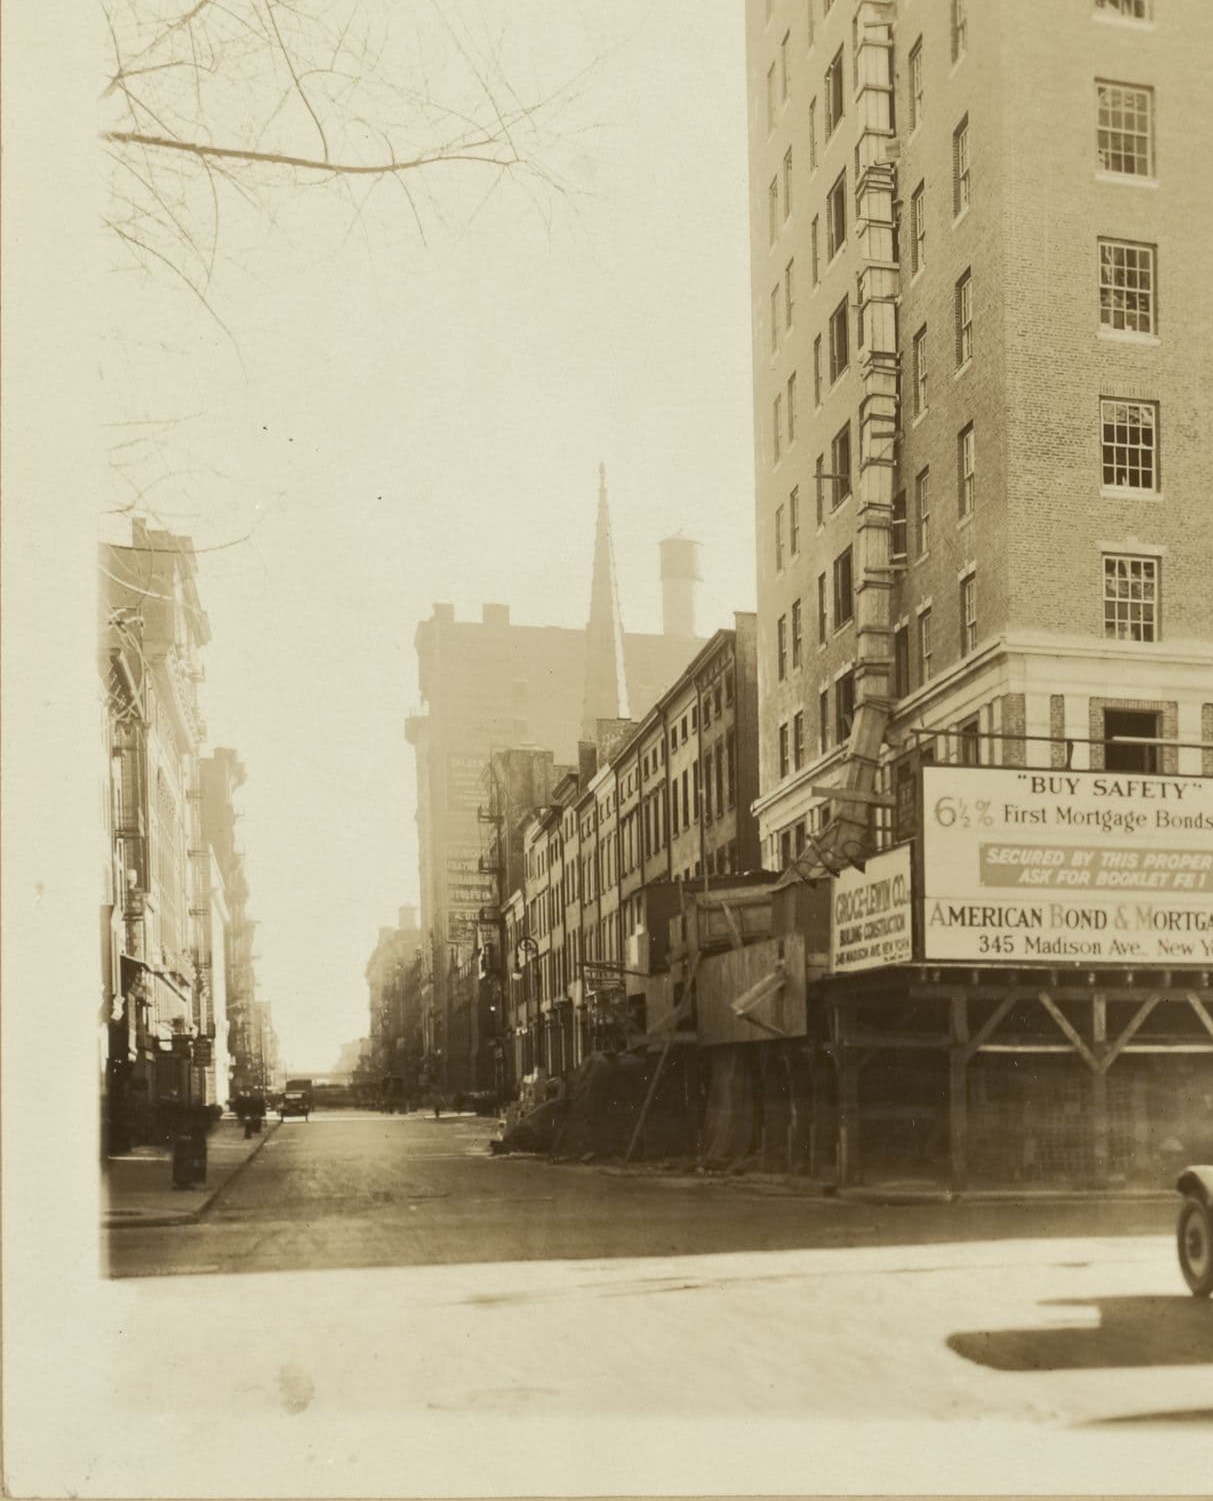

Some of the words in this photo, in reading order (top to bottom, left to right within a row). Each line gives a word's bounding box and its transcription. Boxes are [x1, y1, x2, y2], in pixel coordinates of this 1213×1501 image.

[1004, 804, 1046, 824] First
[1056, 806, 1147, 832] Mortgage
[986, 848, 1065, 867] SECURED
[1070, 850, 1095, 867] BY
[1100, 851, 1139, 869] THIS
[1017, 868, 1052, 885] ASK
[1056, 869, 1090, 886] FOR
[1096, 871, 1169, 888] BOOKLET
[929, 900, 1043, 929] AMERICAN
[1050, 903, 1108, 930] BOND
[1113, 903, 1129, 931] &
[978, 934, 1015, 954] 345
[1024, 936, 1102, 955] Madison
[1157, 939, 1195, 956] New
